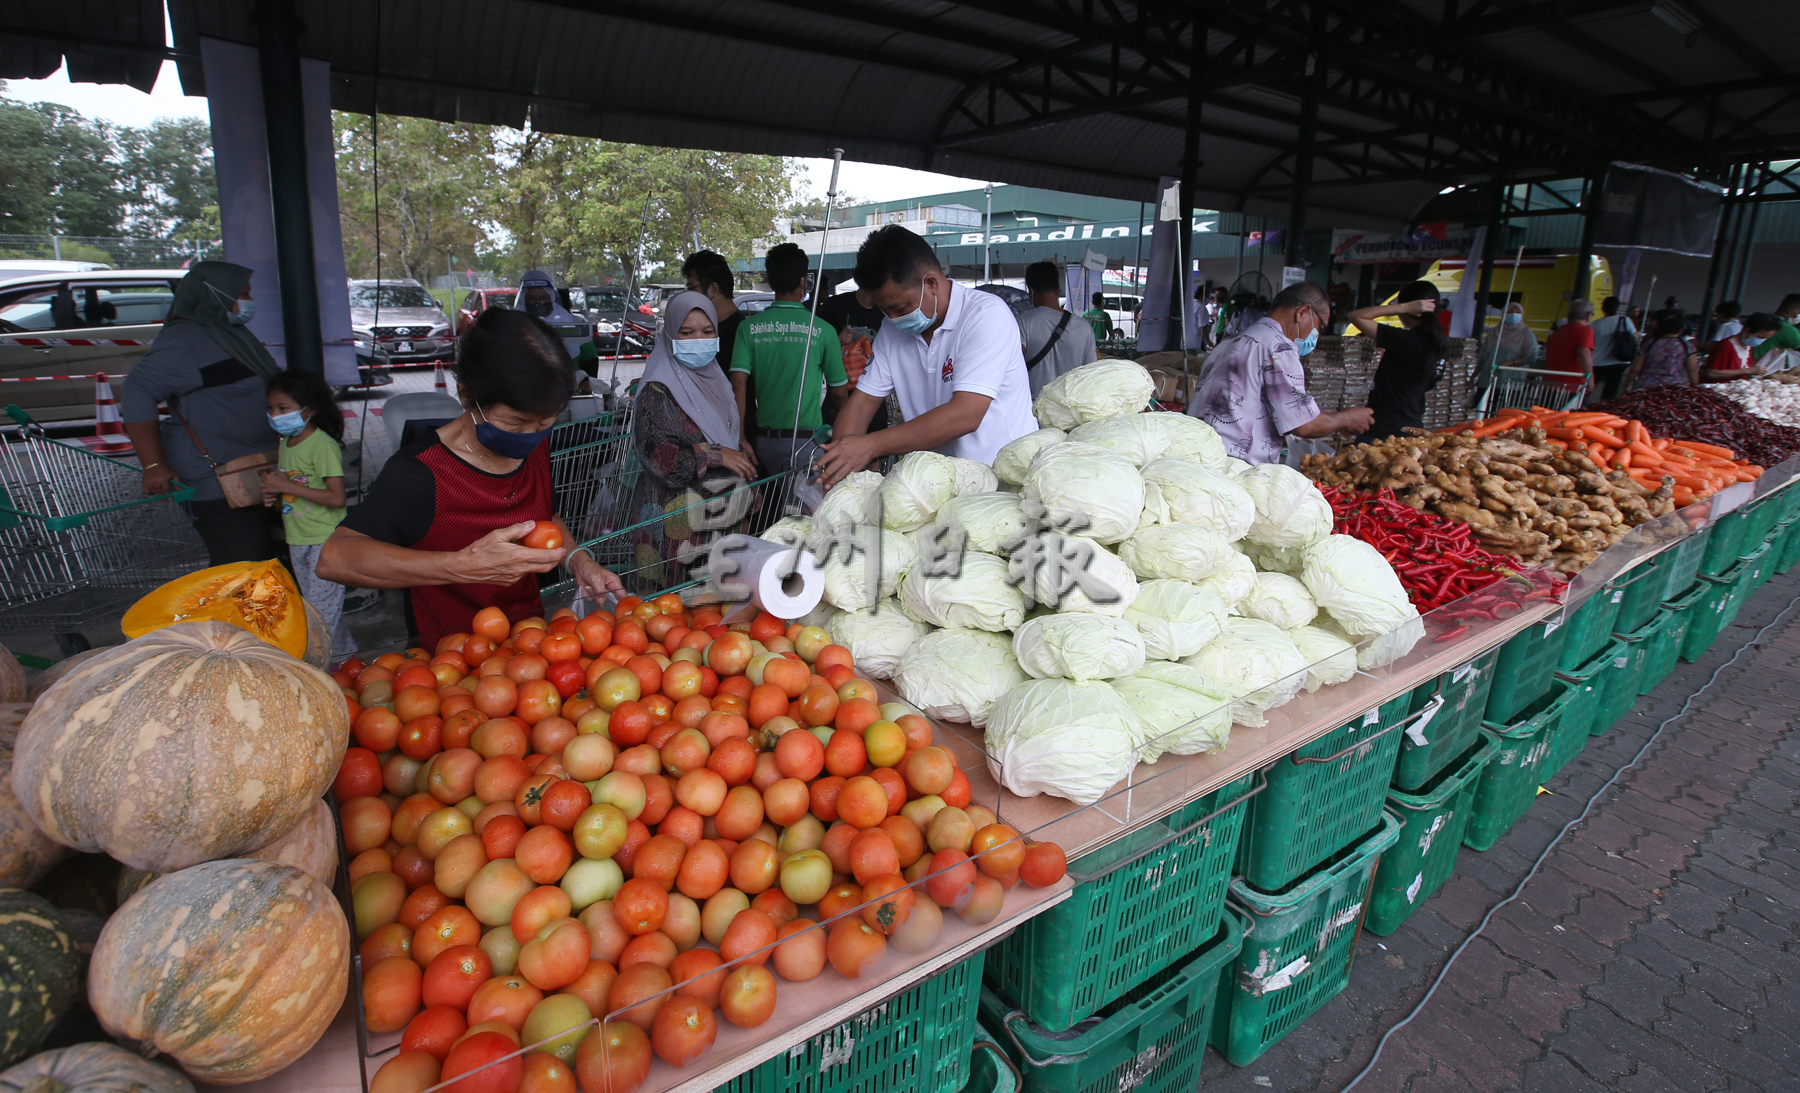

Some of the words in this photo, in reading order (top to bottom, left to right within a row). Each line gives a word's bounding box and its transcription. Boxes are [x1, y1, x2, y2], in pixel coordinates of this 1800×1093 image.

[750, 321, 774, 335] Bolehkah
[775, 321, 789, 336] Saya
[790, 321, 822, 338] Membatu?
